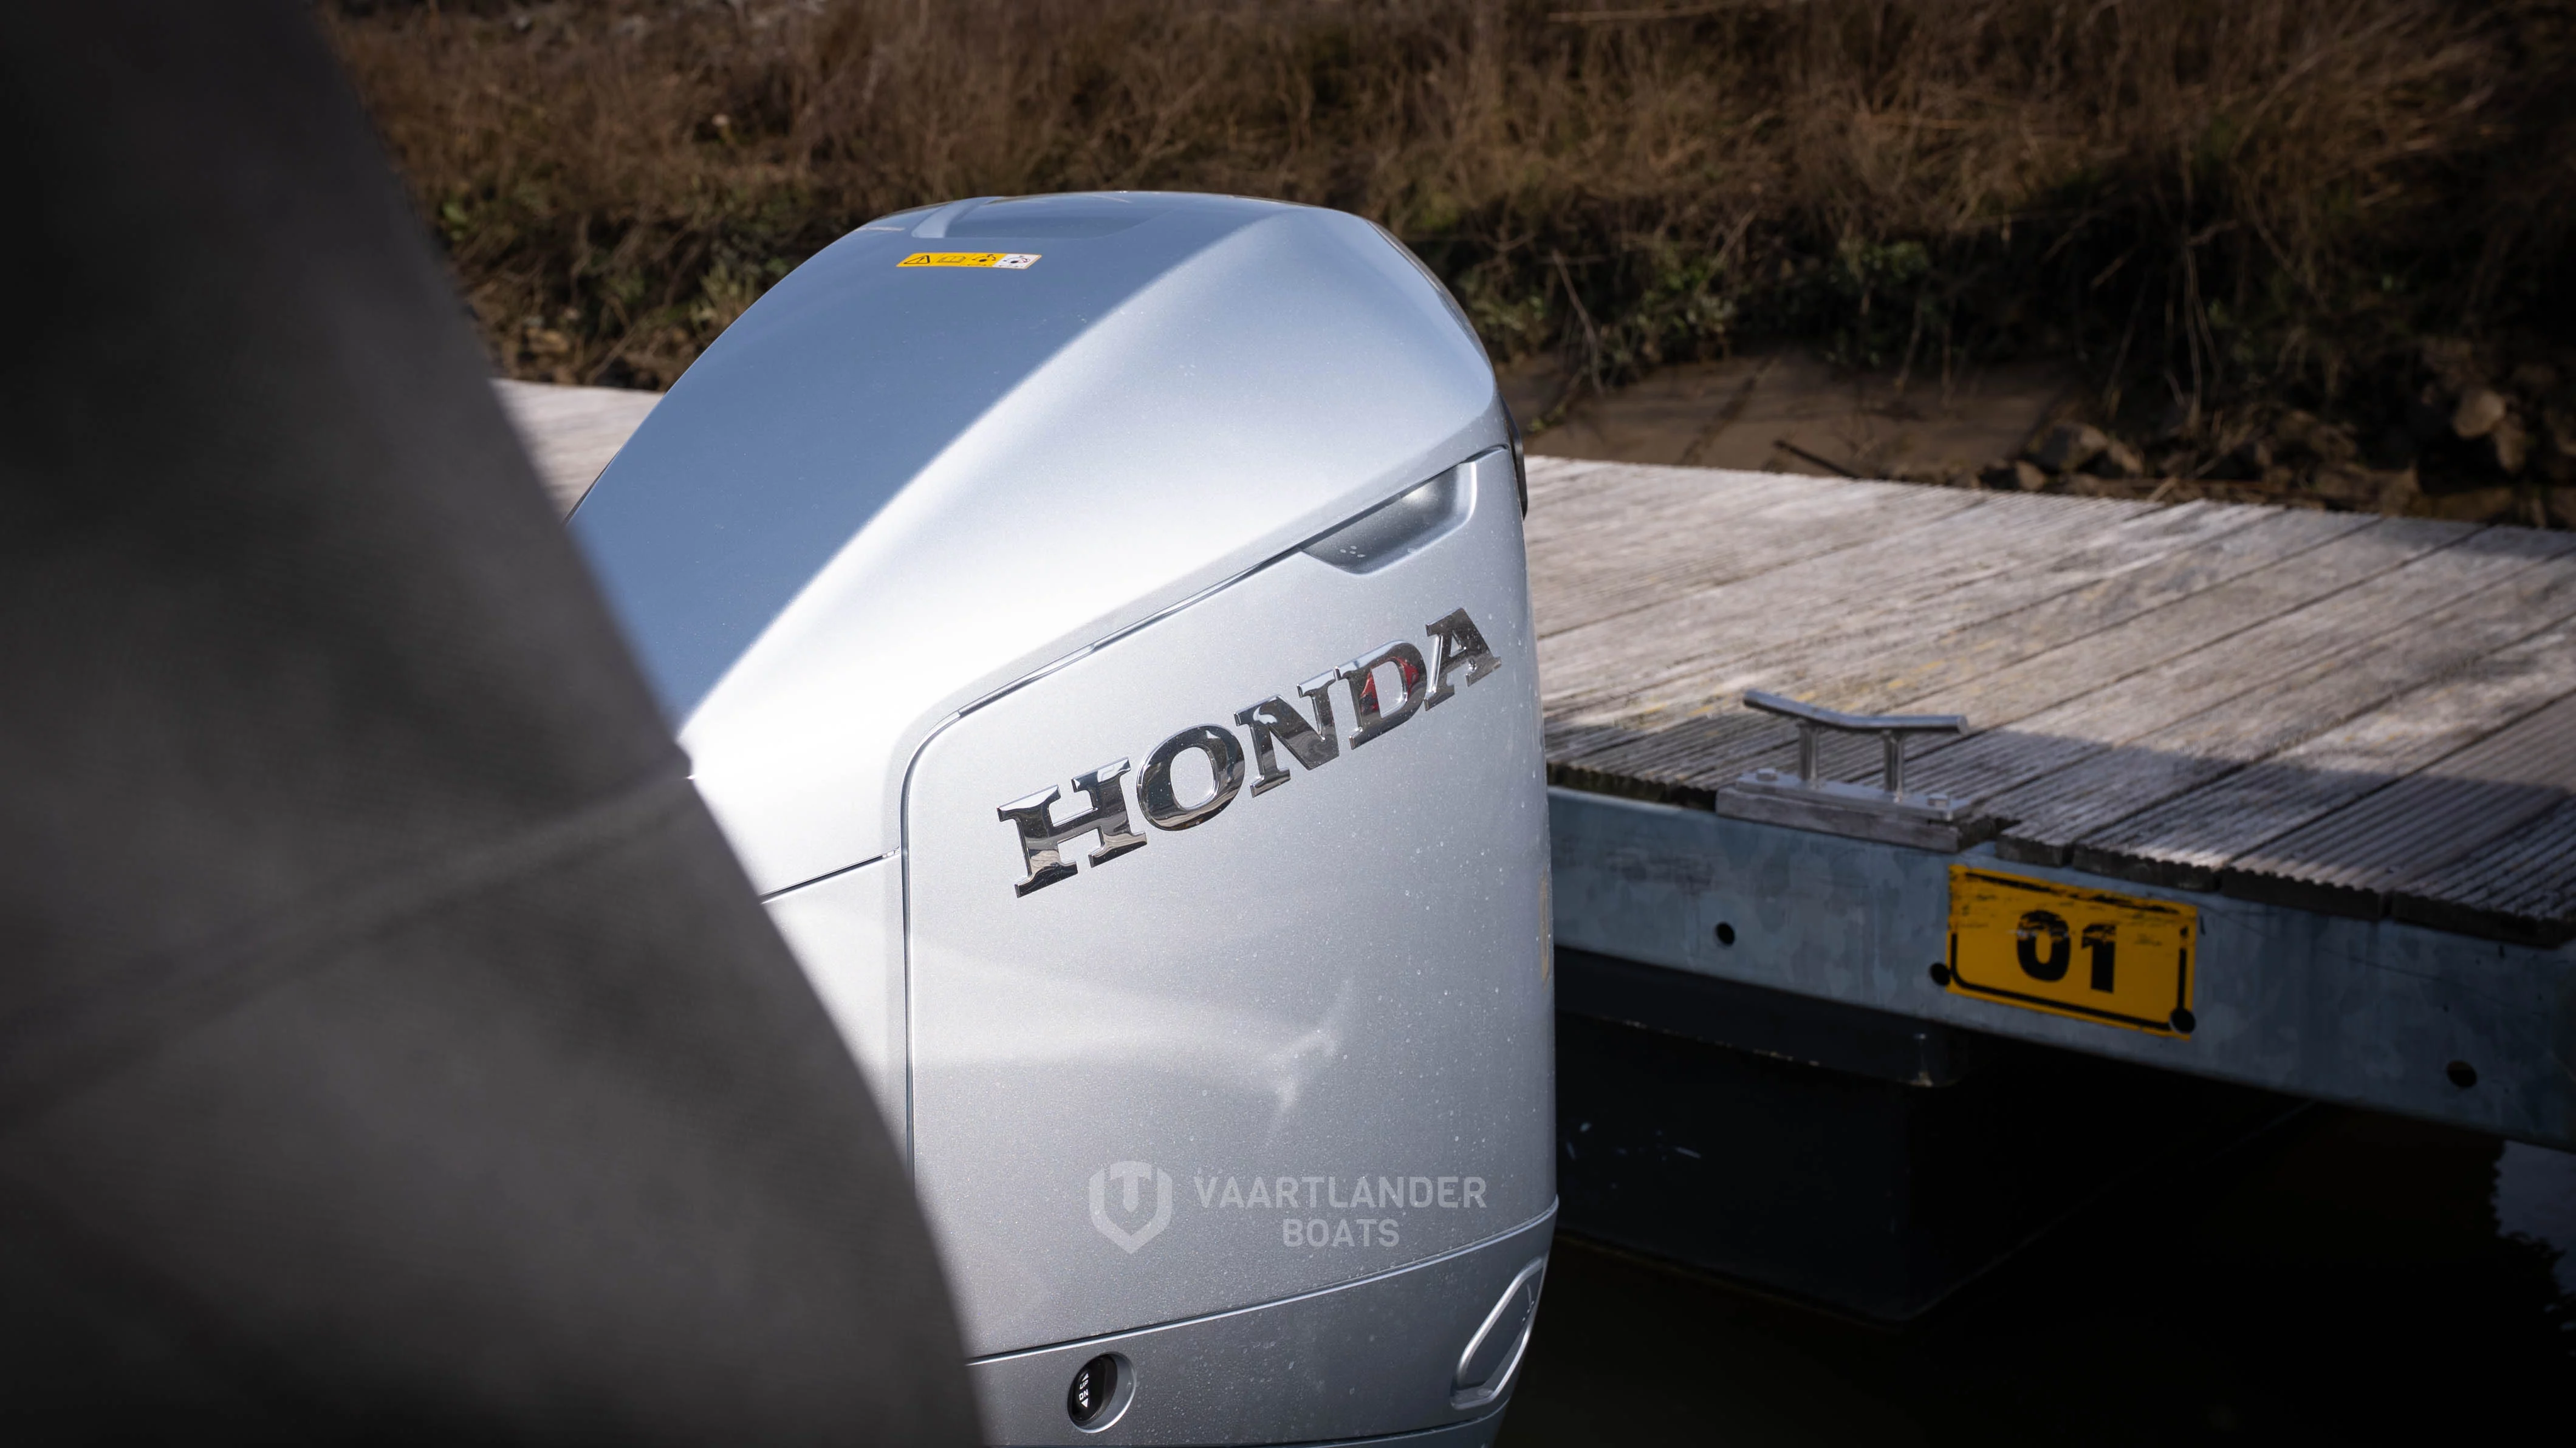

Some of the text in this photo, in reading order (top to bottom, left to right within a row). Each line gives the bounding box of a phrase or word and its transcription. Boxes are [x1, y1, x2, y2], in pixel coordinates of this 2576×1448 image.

[996, 607, 1502, 898] HONDA
[2016, 910, 2117, 993] 01
[1079, 1389, 1089, 1401] DN
[1080, 1379, 1089, 1390] UP
